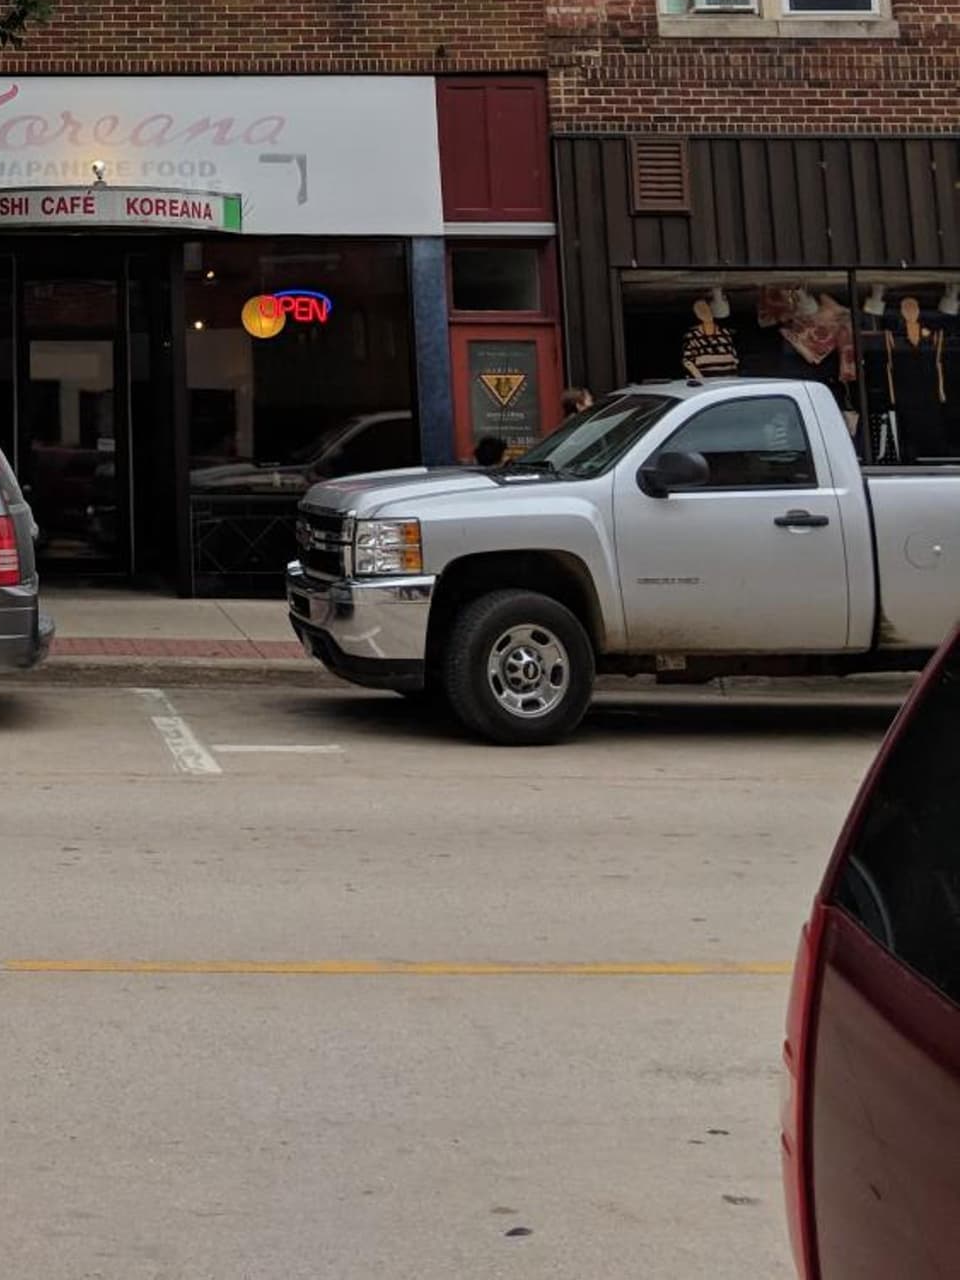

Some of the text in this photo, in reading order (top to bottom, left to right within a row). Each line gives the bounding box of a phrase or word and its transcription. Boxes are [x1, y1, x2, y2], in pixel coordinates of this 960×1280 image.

[141, 159, 217, 177] FOOD
[41, 190, 95, 216] CAFÉ
[126, 197, 213, 221] KOREANA
[258, 295, 326, 322] OPEN
